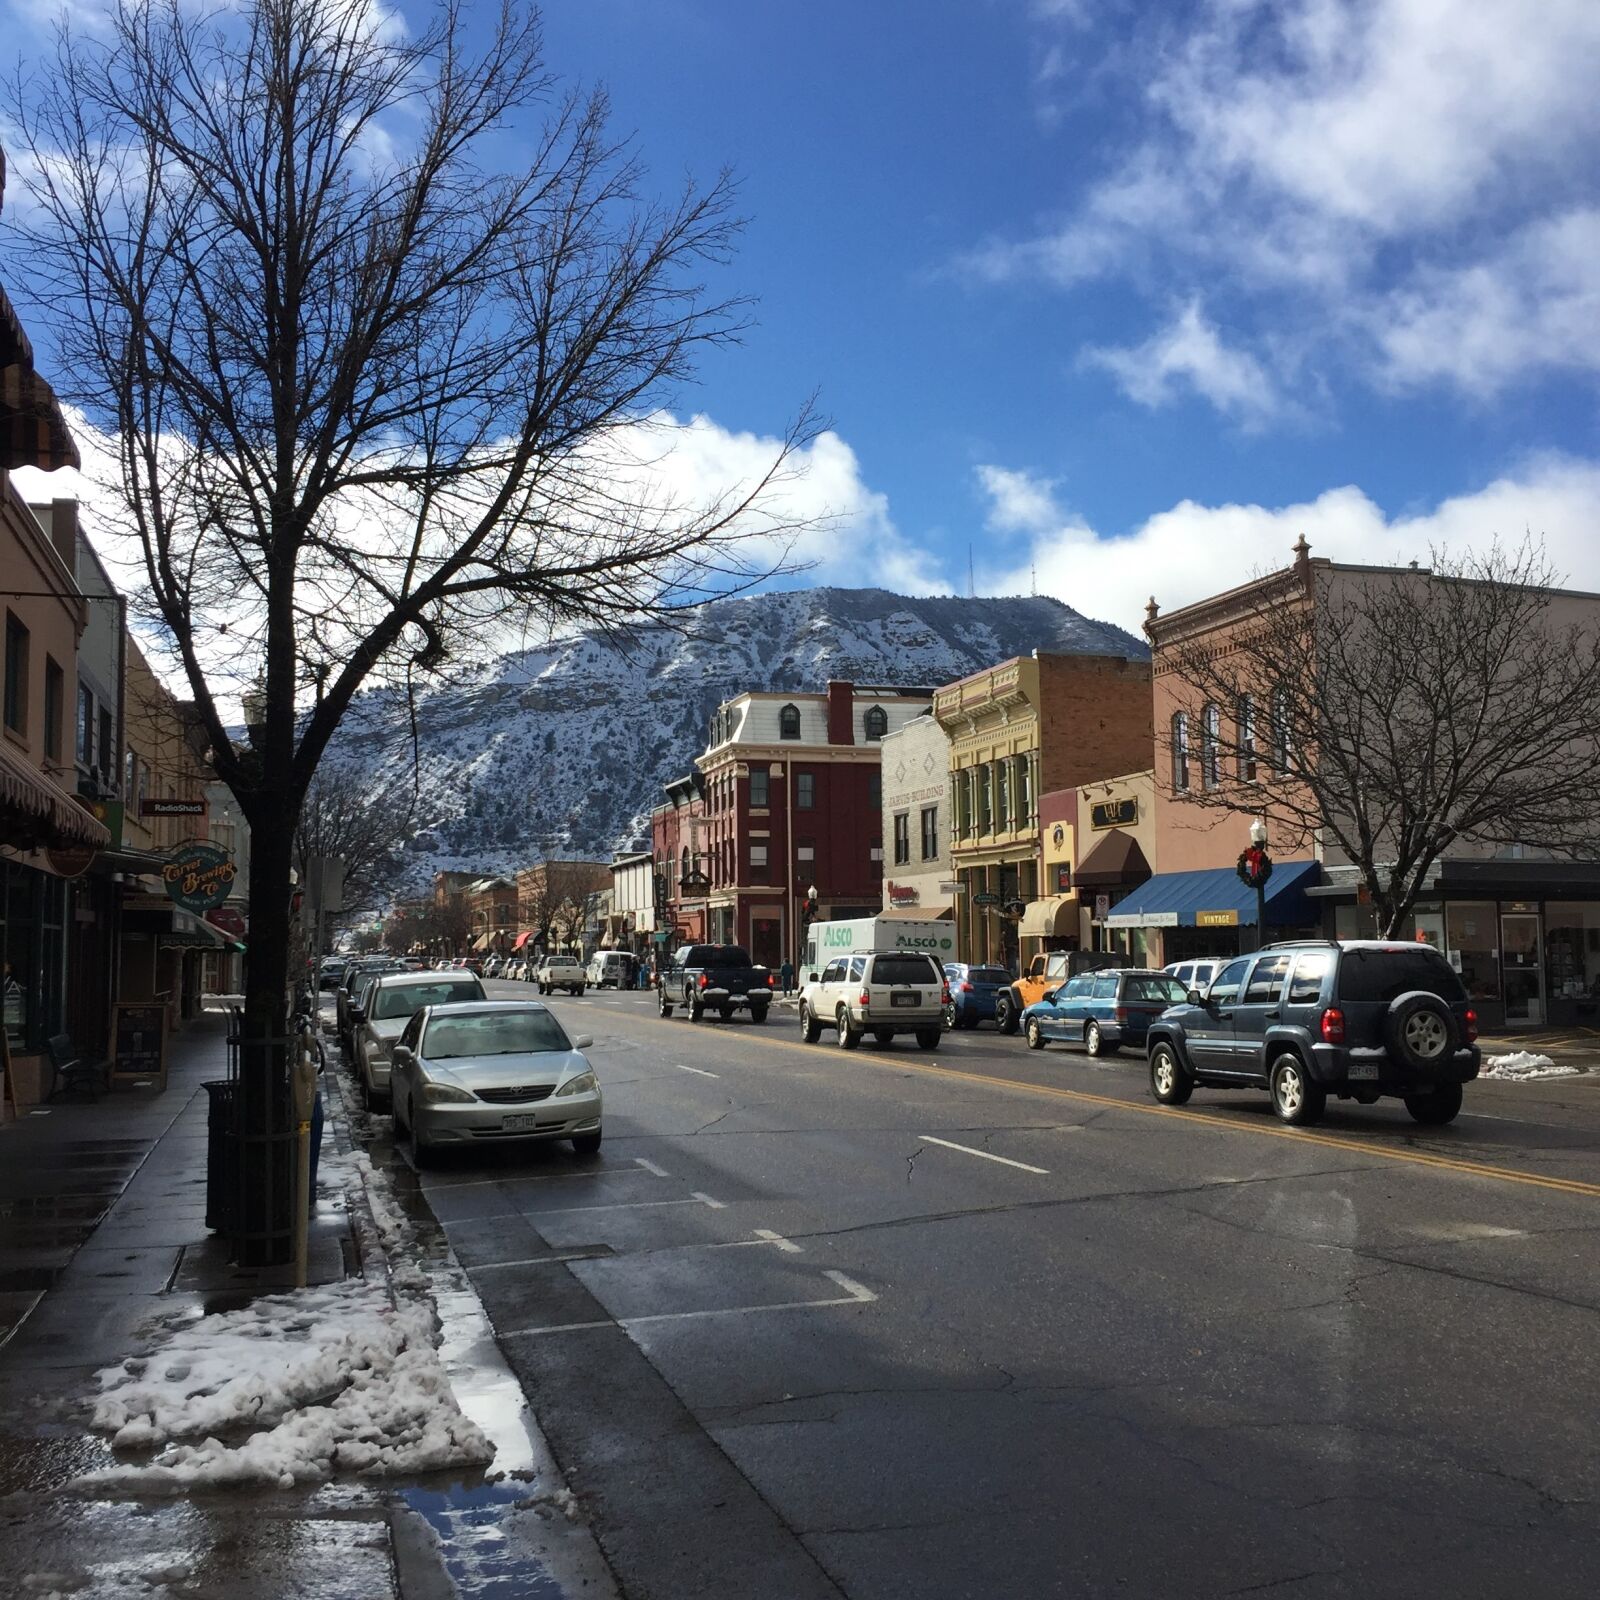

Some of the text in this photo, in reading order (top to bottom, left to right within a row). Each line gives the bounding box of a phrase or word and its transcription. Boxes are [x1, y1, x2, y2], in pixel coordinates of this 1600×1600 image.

[912, 784, 944, 802] BUILDING
[154, 803, 203, 812] RadioShack
[163, 859, 202, 882] Carver
[183, 863, 234, 894] Brewing
[1204, 914, 1230, 924] VINTAGE
[824, 925, 852, 947] ALSCO
[896, 935, 938, 948] ALSCO
